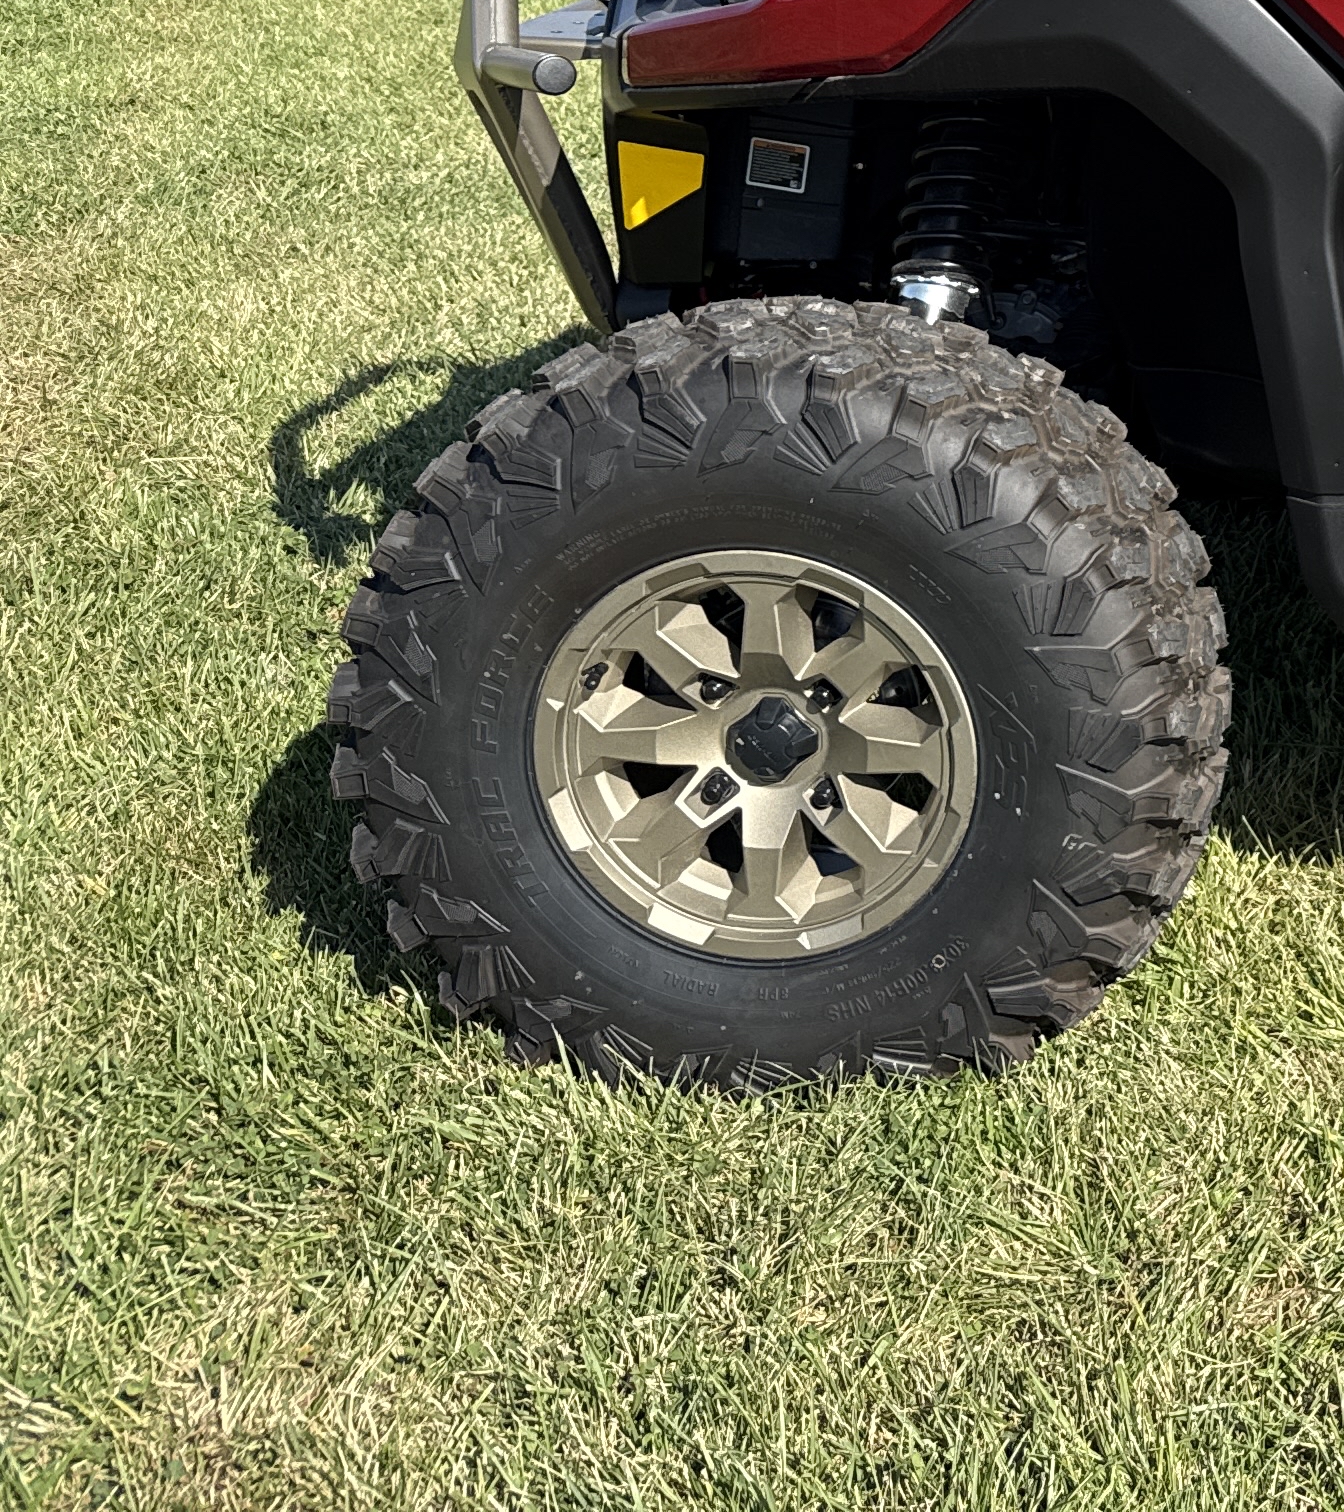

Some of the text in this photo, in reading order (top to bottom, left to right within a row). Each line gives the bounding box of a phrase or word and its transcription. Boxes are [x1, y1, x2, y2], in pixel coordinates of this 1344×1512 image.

[471, 586, 556, 910] TRAC FORCE
[976, 682, 1036, 819] XPS
[658, 969, 718, 997] RADIAL
